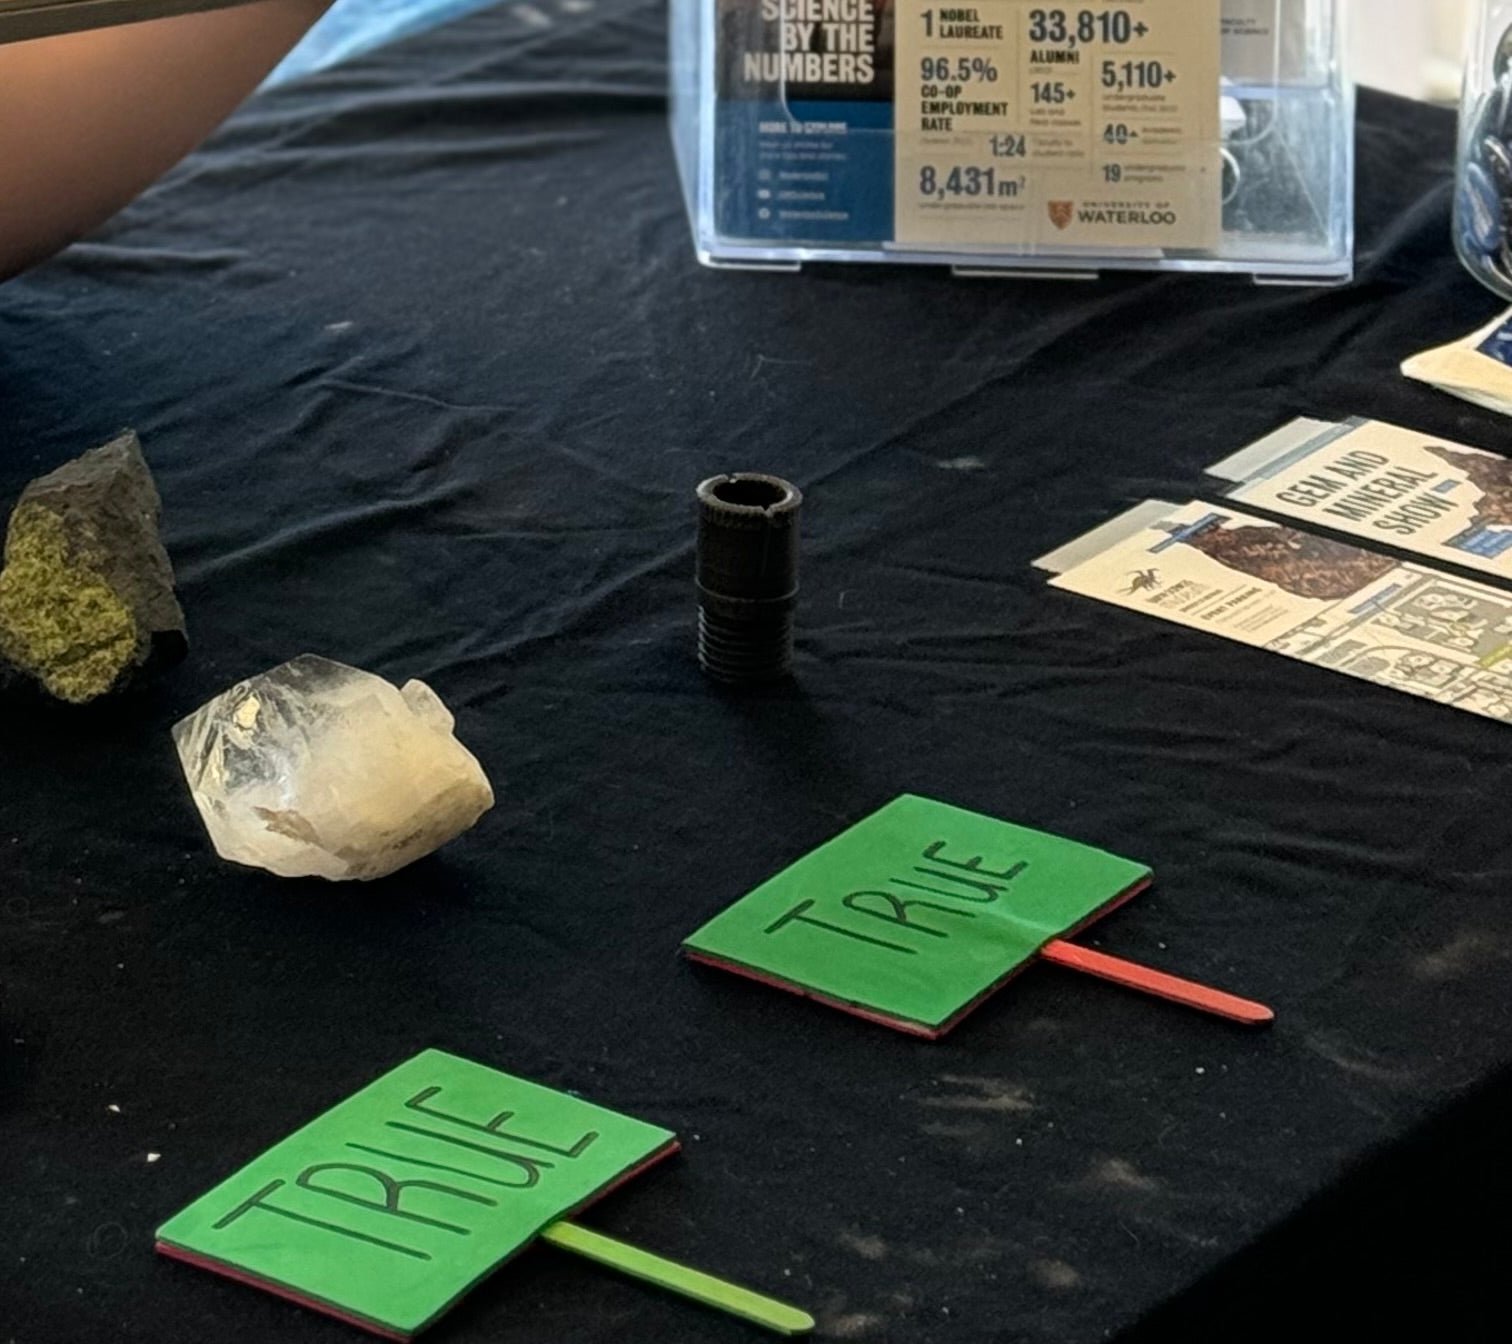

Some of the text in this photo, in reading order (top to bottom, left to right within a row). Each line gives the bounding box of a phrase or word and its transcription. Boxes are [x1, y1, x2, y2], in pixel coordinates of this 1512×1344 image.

[920, 8, 980, 37] 1 NOBEL
[939, 25, 1003, 40] LAUREATE
[1029, 9, 1150, 48] 33,810+
[783, 22, 875, 53] BY THE
[744, 53, 875, 84] NUMBERS
[920, 56, 998, 82] 96.5%
[1030, 50, 1080, 64] ALUMNI
[1101, 60, 1177, 91] 5,110+
[921, 85, 962, 99] CO-OP
[1030, 82, 1076, 103] 145+
[921, 101, 1009, 116] EMPLOYMENT
[921, 118, 953, 132] RATE
[1102, 164, 1122, 182] 19
[1078, 211, 1177, 225] WATERLOO
[1275, 450, 1390, 507] GEM AND
[1322, 466, 1439, 522] MINERAL
[1372, 492, 1459, 535] SHOW
[764, 839, 1031, 954] TRUE
[211, 1084, 600, 1262] TRUE
